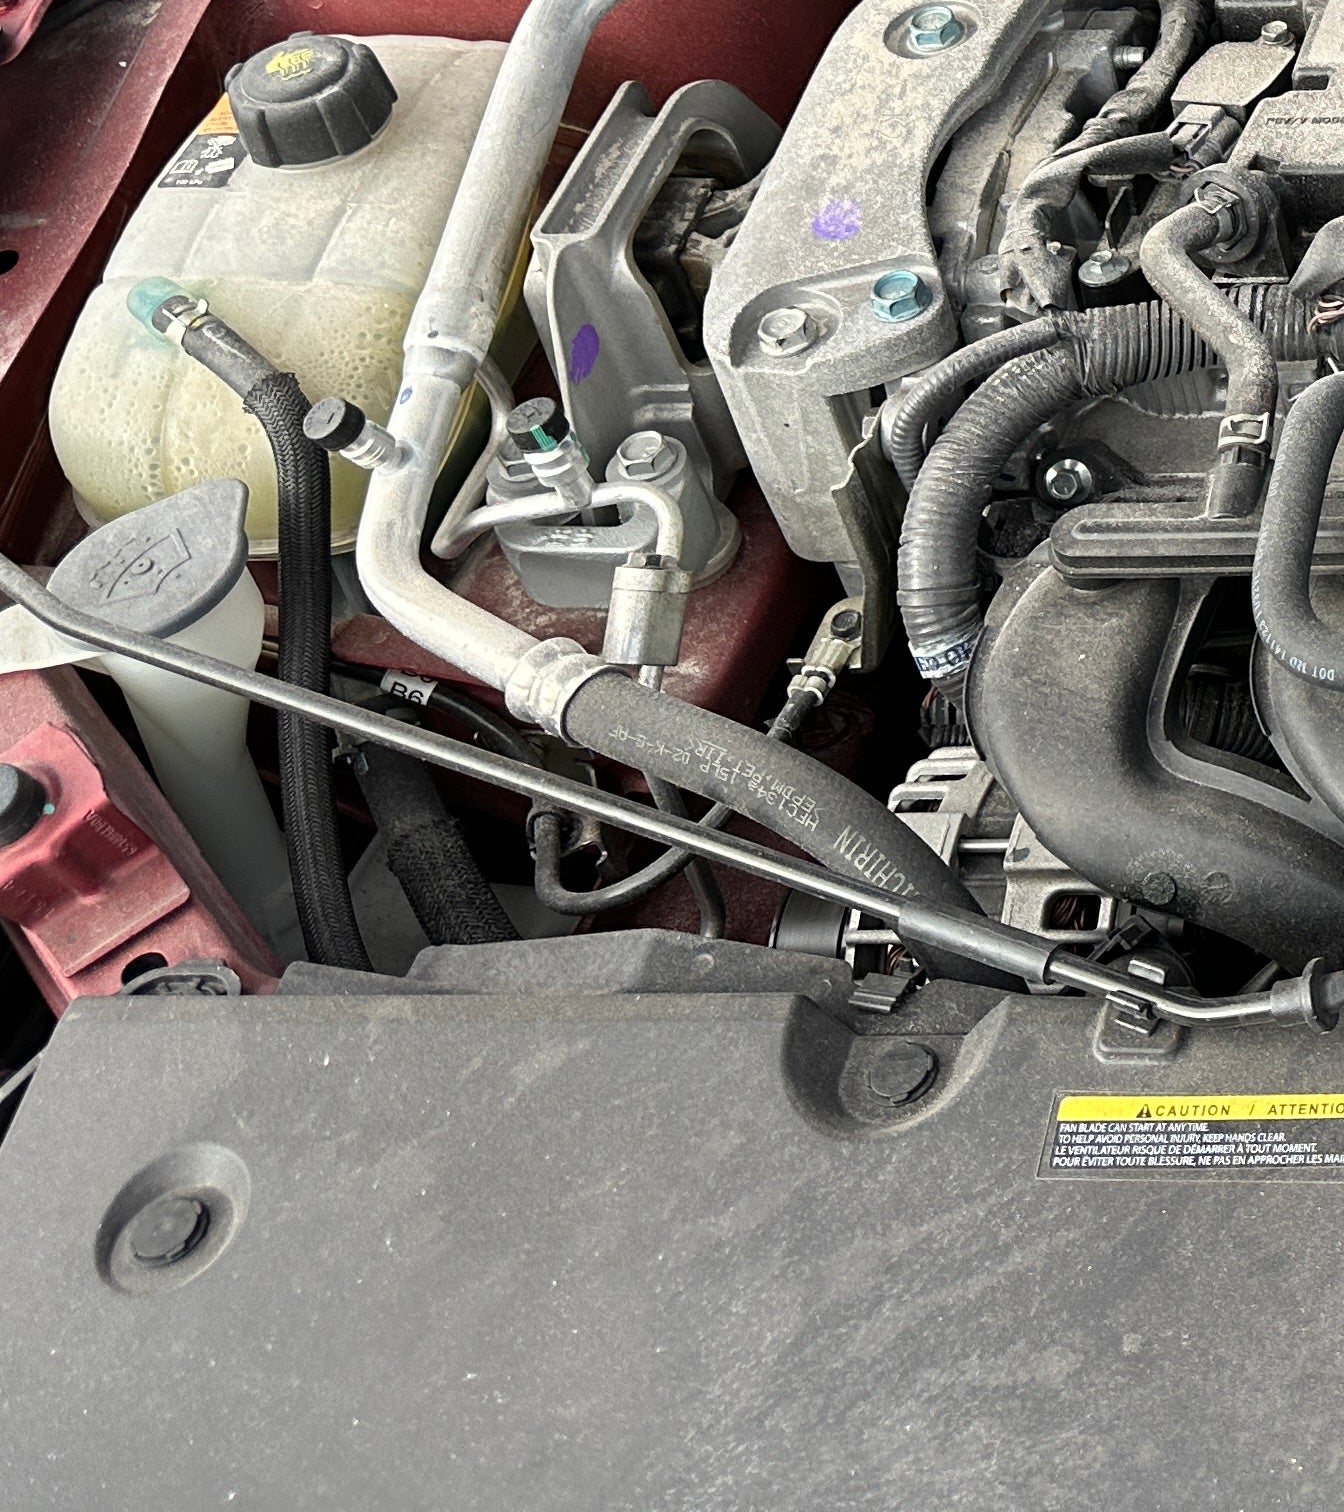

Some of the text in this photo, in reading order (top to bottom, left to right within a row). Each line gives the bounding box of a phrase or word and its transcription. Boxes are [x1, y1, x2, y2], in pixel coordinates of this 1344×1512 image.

[833, 824, 920, 896] ICHIRIN
[1155, 1104, 1231, 1118] CAUTION
[1249, 1104, 1255, 1116] /
[1059, 1123, 1077, 1133] FAN
[1078, 1123, 1107, 1133] BLADE
[1108, 1123, 1127, 1132] CAN
[1128, 1123, 1155, 1132] START
[1155, 1123, 1167, 1132] AT
[1059, 1134, 1071, 1144] TO
[1072, 1134, 1095, 1144] HELP
[1095, 1134, 1123, 1144] AVOID
[1124, 1133, 1168, 1144] PERSONAL
[1203, 1133, 1224, 1143] KEEP
[1225, 1133, 1256, 1142] HANDS
[1257, 1132, 1287, 1142] CLEAR.
[1055, 1145, 1068, 1155] LE
[1068, 1145, 1131, 1155] VENTILATEUR
[1132, 1145, 1168, 1156] RISQUE
[1168, 1145, 1182, 1155] DE
[1183, 1143, 1235, 1154] DÉMARRER
[1245, 1143, 1271, 1153] TOUT
[1053, 1156, 1081, 1166] POUR
[1082, 1155, 1115, 1166] ÉVITER
[1115, 1156, 1147, 1166] TOUTE
[1198, 1155, 1211, 1165] NE
[1213, 1155, 1231, 1165] PAS
[1232, 1155, 1247, 1165] EN
[1247, 1154, 1306, 1165] APPROCHER
[1307, 1154, 1323, 1164] LES
